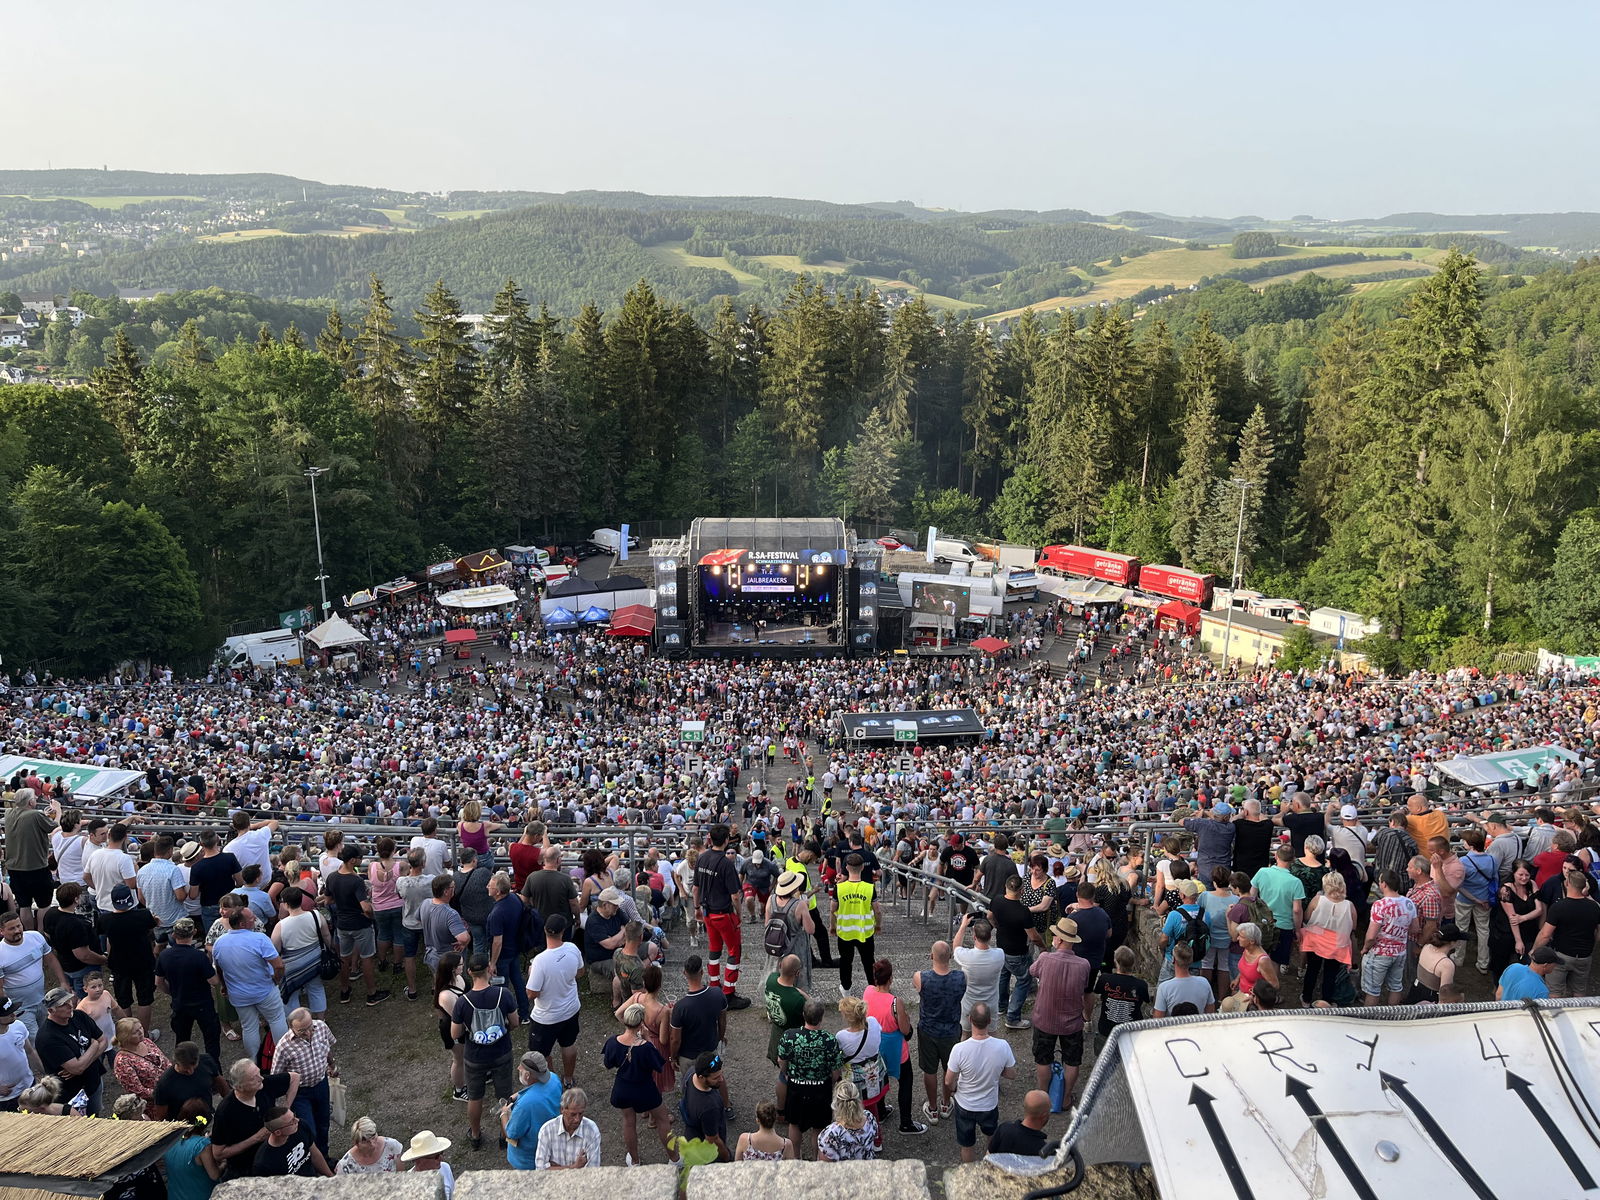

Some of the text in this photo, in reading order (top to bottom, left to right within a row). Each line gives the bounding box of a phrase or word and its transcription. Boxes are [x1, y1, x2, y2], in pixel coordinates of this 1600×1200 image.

[748, 551, 799, 560] R.SA-FESTIVAL
[855, 729, 864, 738] C
[715, 736, 722, 744] D
[689, 759, 698, 771] F
[901, 759, 910, 771] E
[842, 893, 867, 902] STEWARD
[1165, 1038, 1209, 1079] C
[1252, 1030, 1317, 1073] R
[1473, 1023, 1510, 1068] 4
